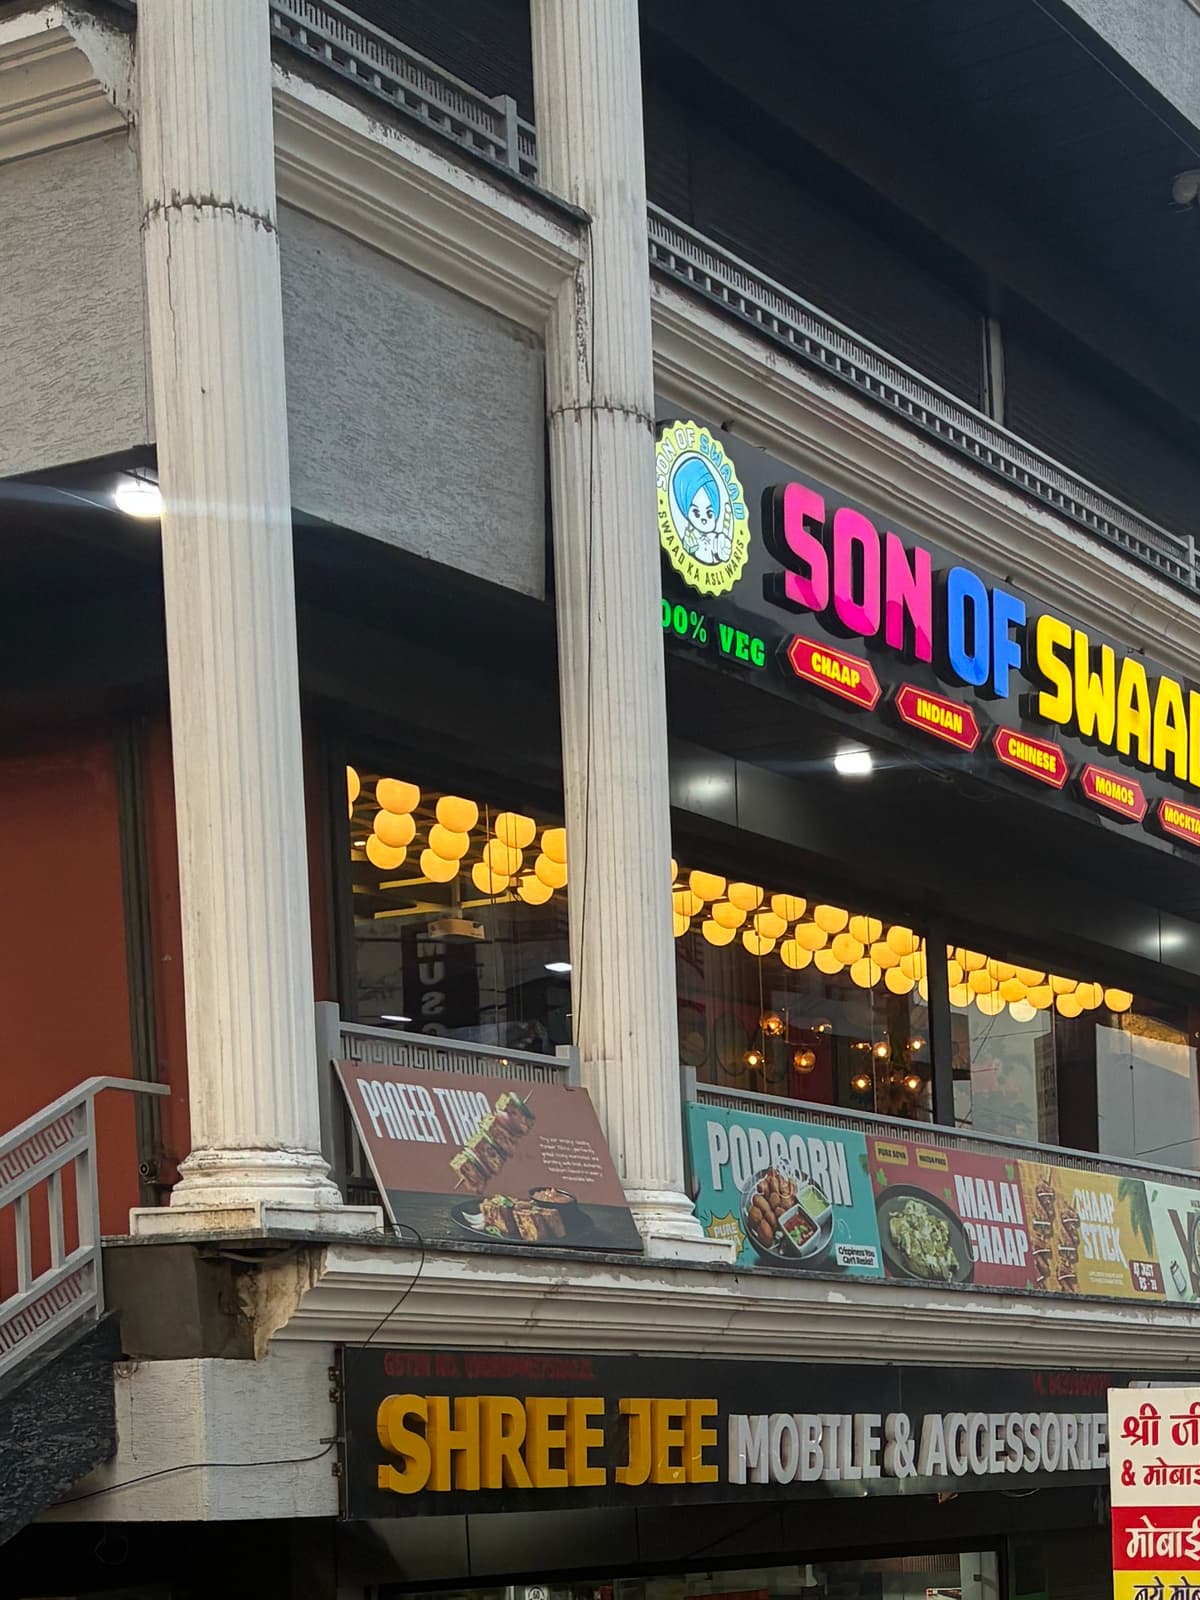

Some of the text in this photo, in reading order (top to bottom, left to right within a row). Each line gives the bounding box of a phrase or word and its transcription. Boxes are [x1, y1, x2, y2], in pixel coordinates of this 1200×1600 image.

[656, 442, 676, 492] SON
[675, 428, 695, 449] OF
[658, 510, 744, 587] SWAAD KA ASLI WARIS
[780, 481, 933, 664] SON
[947, 565, 1027, 699] OF
[661, 598, 766, 667] 00% VEG
[810, 652, 861, 690] CHAAP
[915, 698, 964, 734] INDIAN
[1007, 737, 1058, 774] CHINESE
[1094, 775, 1136, 807] MOMOS
[356, 1078, 447, 1145] PANEER
[706, 1120, 853, 1207] POPCORN
[953, 1174, 1024, 1225] MALAI
[1073, 1187, 1115, 1226] CHAAP
[962, 1222, 1028, 1268] CHAAP
[1080, 1223, 1129, 1269] STICK
[376, 1393, 1110, 1495] SHREE JEE MOBILE & ACCESSORIE
[1120, 1402, 1162, 1447] श्री
[1120, 1458, 1137, 1487] &
